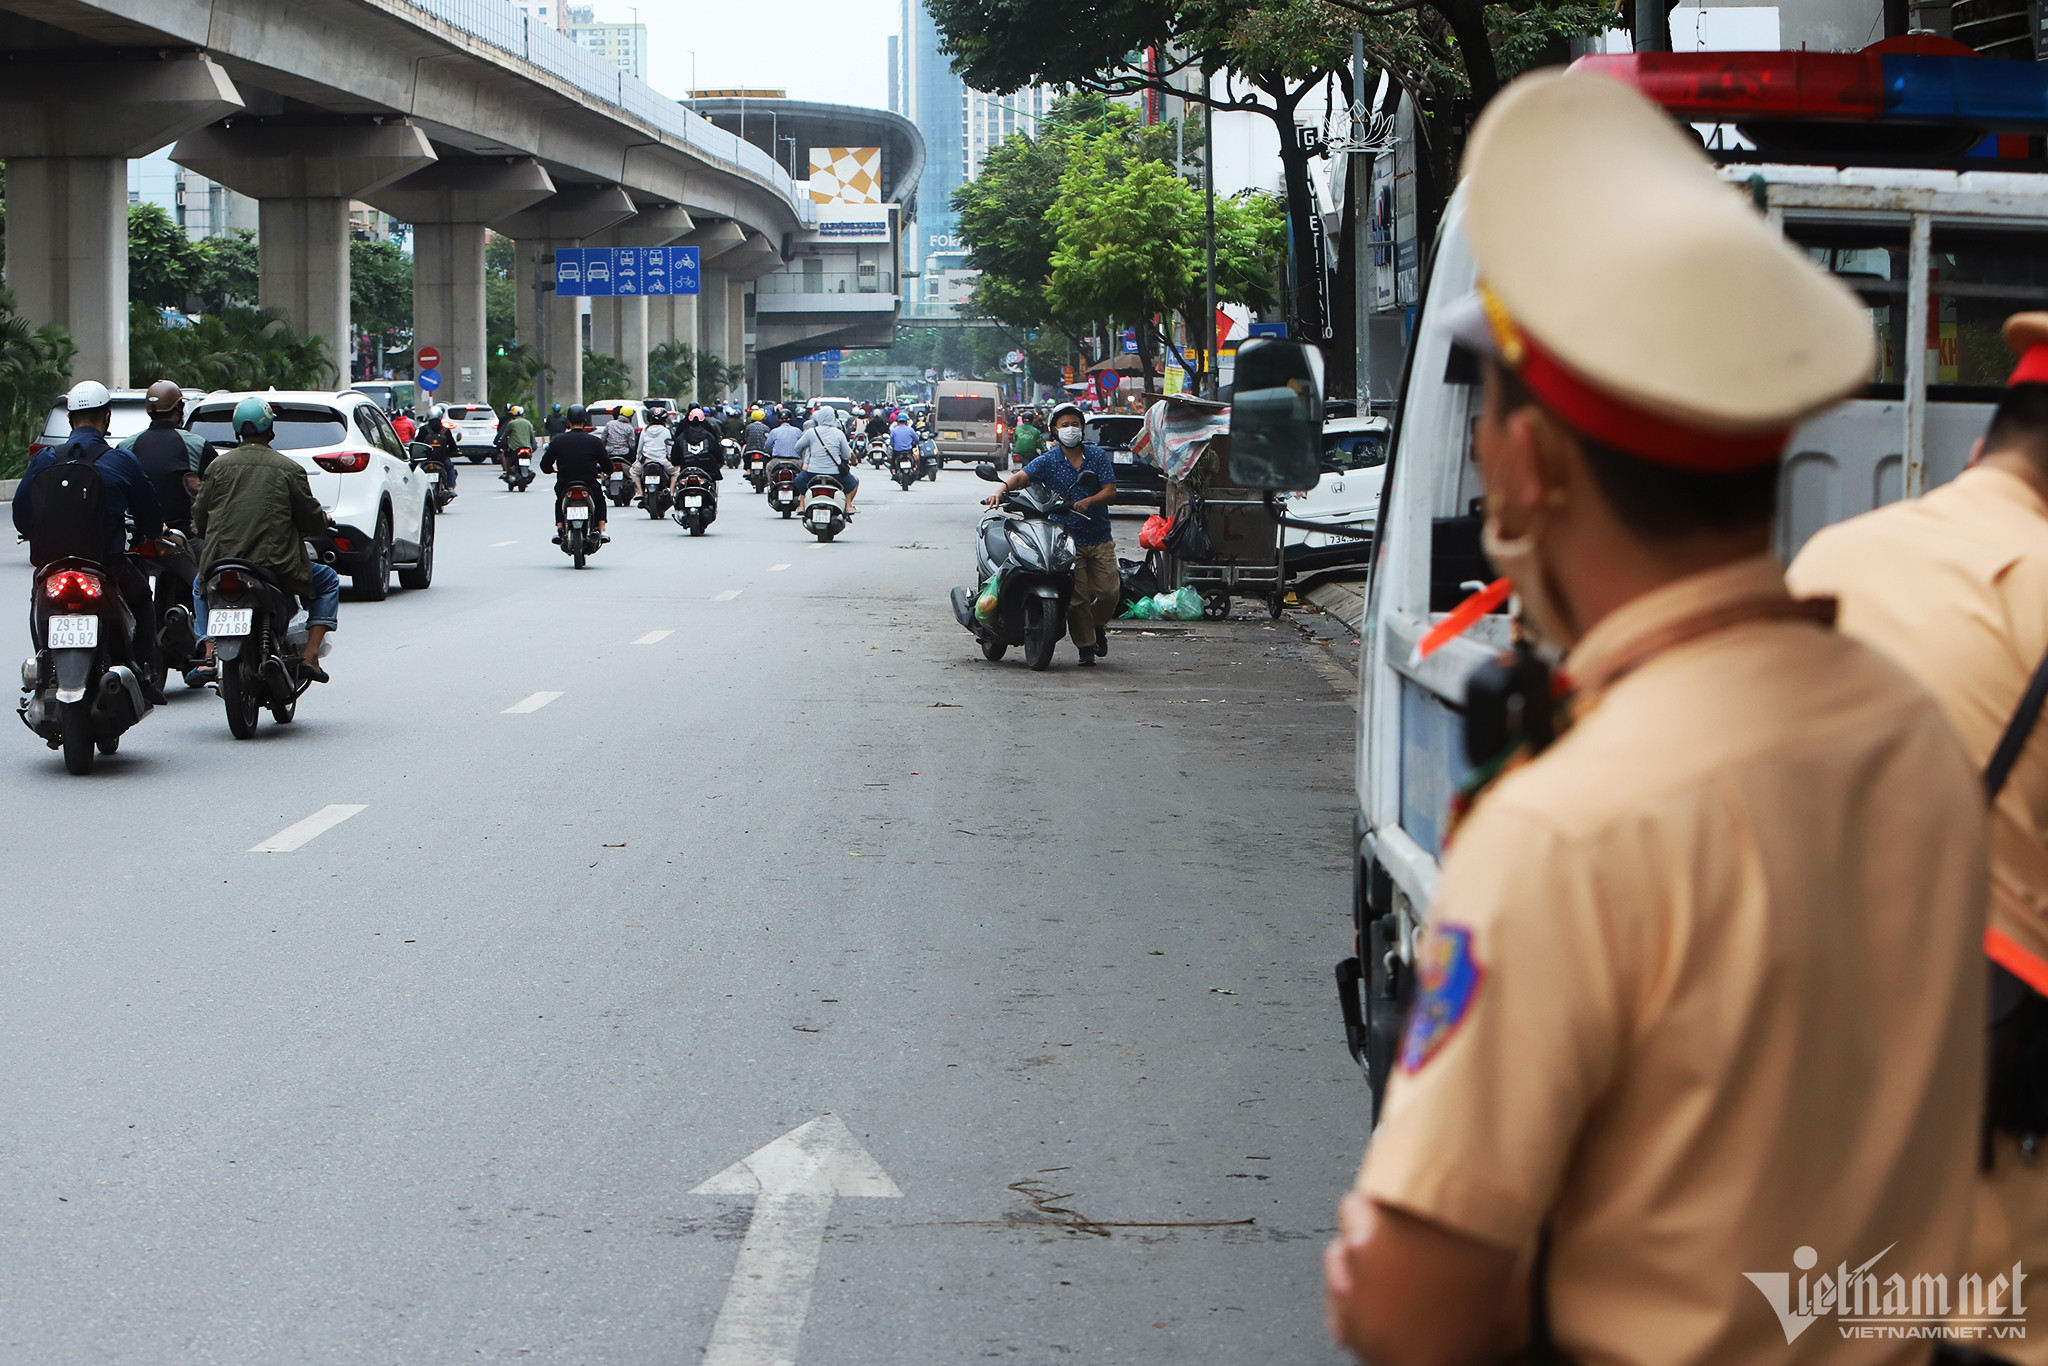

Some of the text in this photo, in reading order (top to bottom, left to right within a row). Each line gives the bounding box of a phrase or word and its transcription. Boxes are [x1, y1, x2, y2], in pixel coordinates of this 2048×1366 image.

[215, 611, 246, 622] 29-M1
[56, 618, 91, 632] 29-E1
[210, 622, 249, 635] 071.68
[51, 632, 94, 646] 849.82
